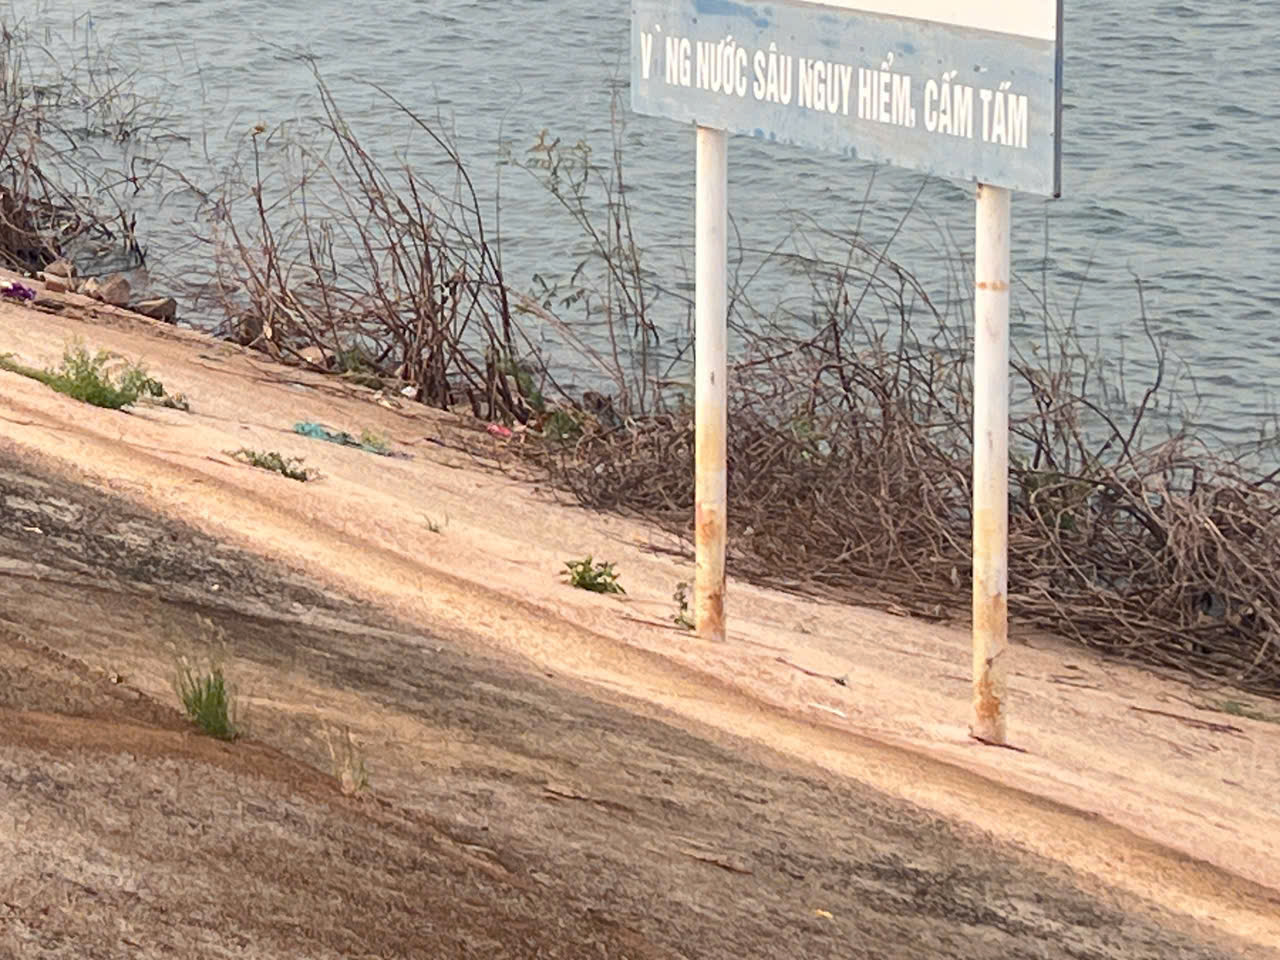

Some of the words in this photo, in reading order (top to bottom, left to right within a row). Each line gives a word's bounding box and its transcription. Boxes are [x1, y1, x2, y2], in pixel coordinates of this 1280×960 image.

[640, 24, 691, 86] VNG
[696, 35, 747, 97] NƯỚC
[753, 42, 792, 105] SÂU
[798, 57, 852, 115] NGUY
[924, 70, 973, 138] CẤM
